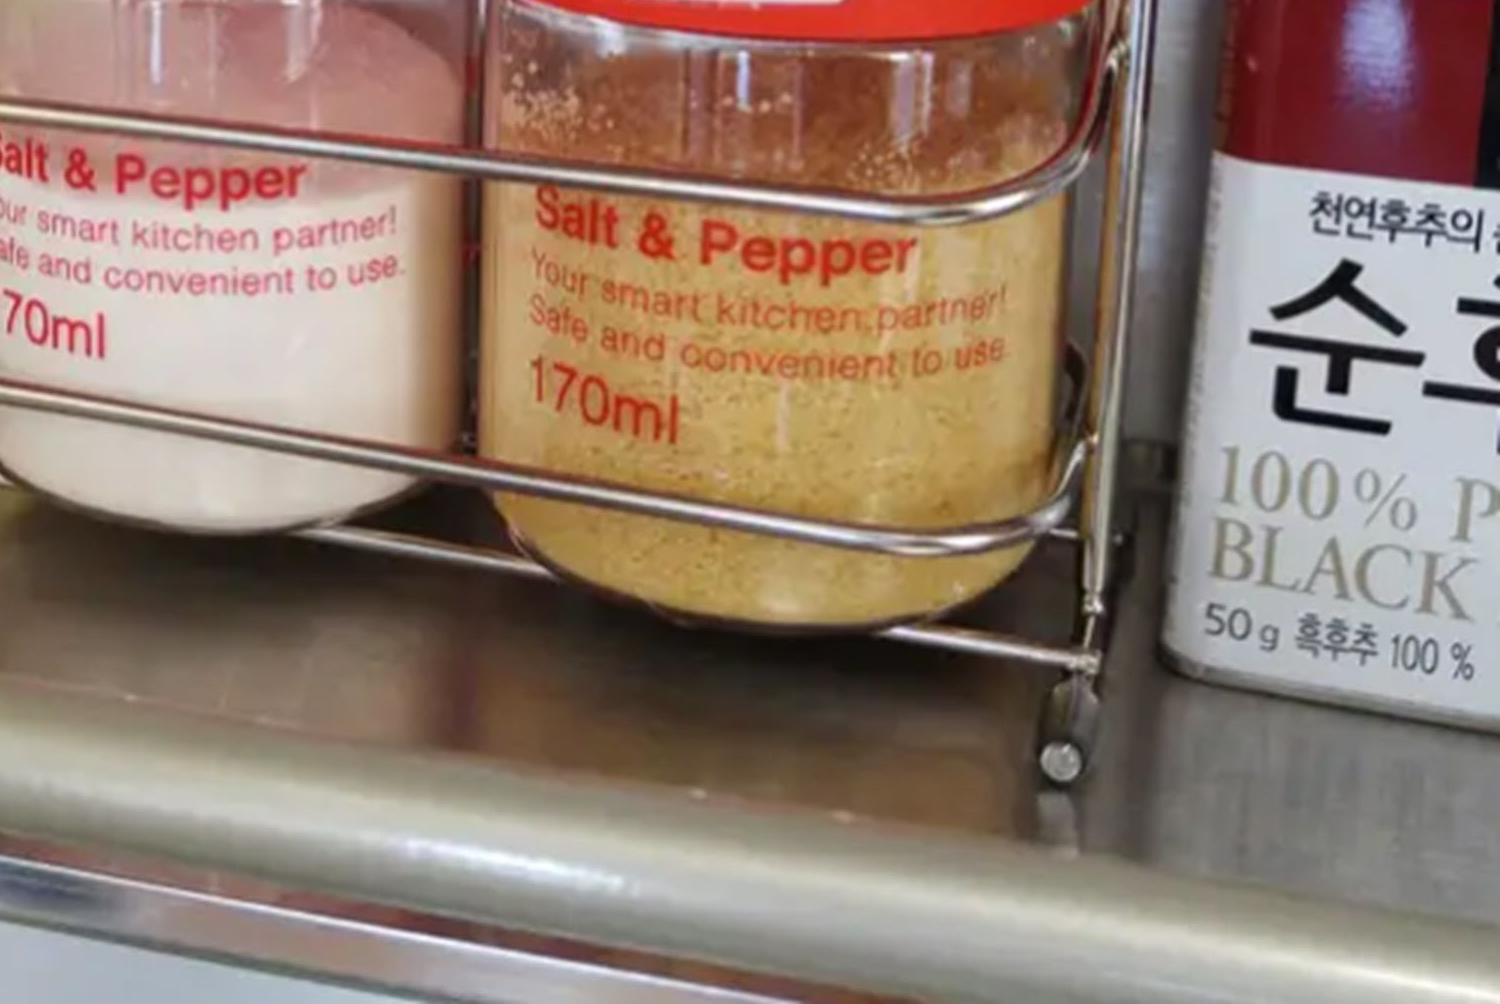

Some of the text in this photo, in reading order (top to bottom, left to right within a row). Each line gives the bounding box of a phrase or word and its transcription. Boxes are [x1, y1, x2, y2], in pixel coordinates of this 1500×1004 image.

[64, 147, 96, 191] &
[116, 154, 308, 210] Pepper
[37, 207, 121, 245] smart
[132, 218, 260, 253] kitchen
[273, 205, 398, 256] partner!
[535, 183, 920, 287] Salt & Pepper
[1309, 192, 1485, 253] 천연후추의
[38, 250, 93, 284] and
[103, 262, 296, 296] convenient
[305, 264, 337, 291] to
[531, 248, 589, 297] Your
[600, 277, 704, 321] smart
[716, 293, 867, 335] kitchen
[530, 294, 589, 343] Safe
[601, 326, 666, 361] and
[680, 339, 899, 383] convenient
[912, 351, 943, 379] to
[530, 356, 680, 444] 170ml
[1209, 517, 1479, 623] BLACK
[1294, 612, 1379, 667] 흑후추
